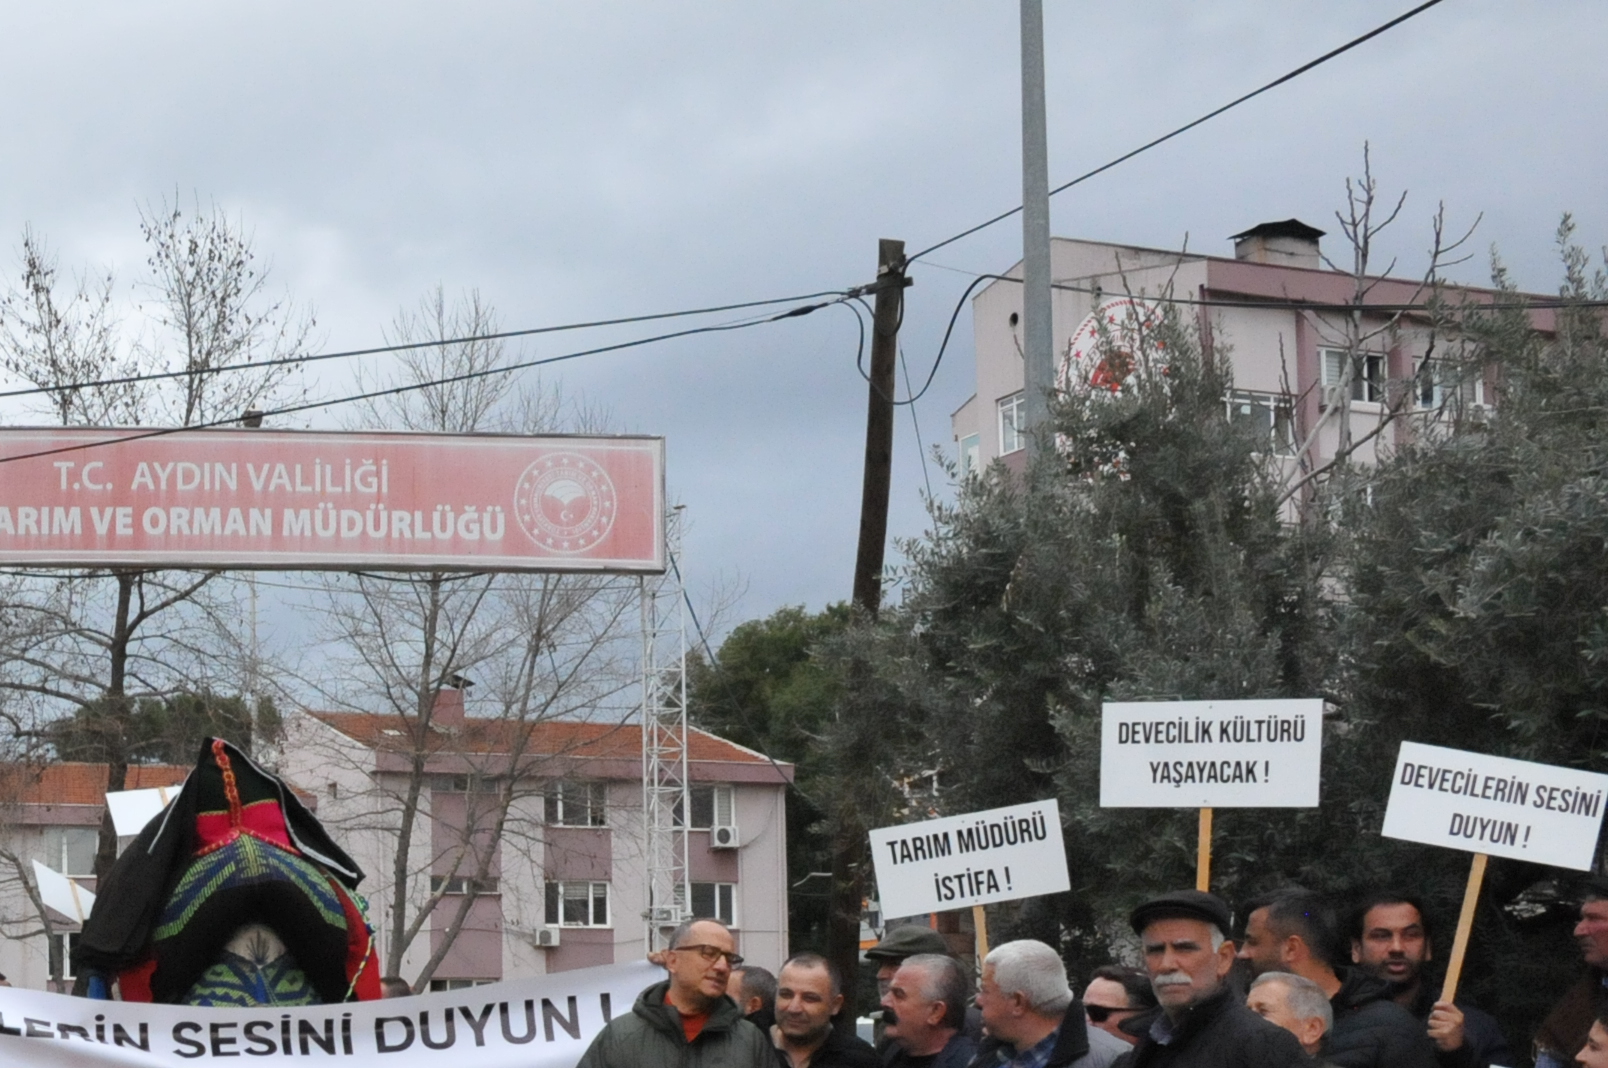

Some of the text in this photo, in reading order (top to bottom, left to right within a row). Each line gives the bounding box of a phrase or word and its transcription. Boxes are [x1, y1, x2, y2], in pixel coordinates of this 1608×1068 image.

[53, 458, 389, 493] T.C. AYDIN VALİLİĞİ
[89, 506, 135, 536] VE
[142, 506, 272, 537] ORMAN
[282, 502, 506, 540] MÜDÜRLÜĞÜ
[1117, 714, 1306, 745] DEVECİLİK KÜLTÜRÜ
[1149, 760, 1269, 789] YAŞAYACAK !
[1400, 762, 1602, 818] DEVECİLERİN SESİNİ
[887, 811, 1047, 866] TARIM MÜDÜRÜ
[1449, 813, 1531, 849] DUYUN !
[933, 866, 1012, 903] İSTİFA !
[171, 1012, 354, 1058] SESİNİ
[373, 995, 582, 1054] DUYUN
